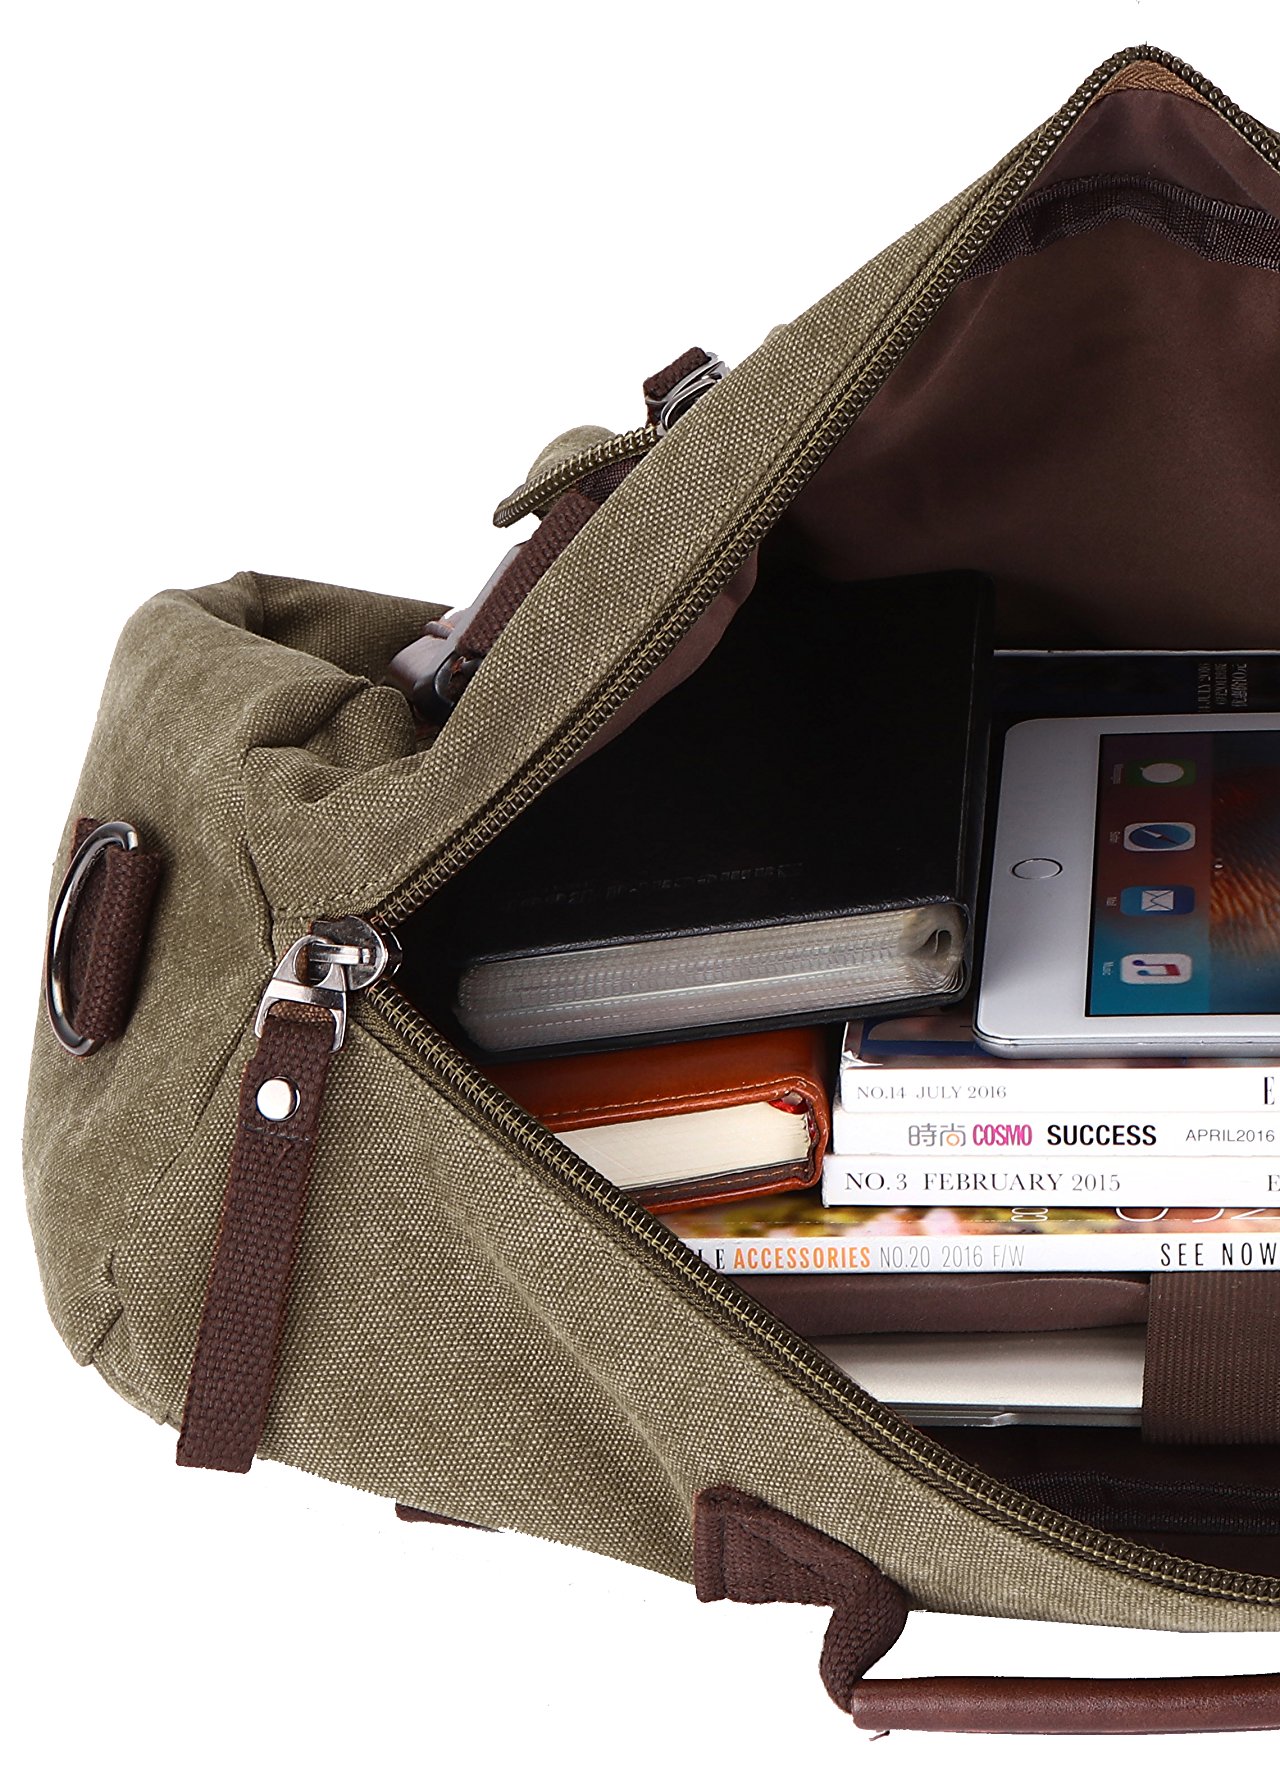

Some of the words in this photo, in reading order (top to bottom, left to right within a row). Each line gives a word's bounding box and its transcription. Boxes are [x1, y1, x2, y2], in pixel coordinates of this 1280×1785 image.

[857, 1085, 905, 1100] NO.14
[915, 1085, 962, 1100] JULY
[967, 1085, 1007, 1100] 2016
[972, 1123, 1034, 1147] COSMO
[1046, 1123, 1157, 1147] SUCCESS
[923, 1172, 1064, 1192] FEBRUARY
[1071, 1172, 1121, 1192] 2015
[733, 1246, 871, 1270] ACCESSORIES
[879, 1245, 931, 1269] NO.20
[941, 1245, 983, 1269] 2016
[993, 1244, 1026, 1268] F/W
[1160, 1242, 1205, 1267] SEE
[1222, 1242, 1278, 1266] NOW
